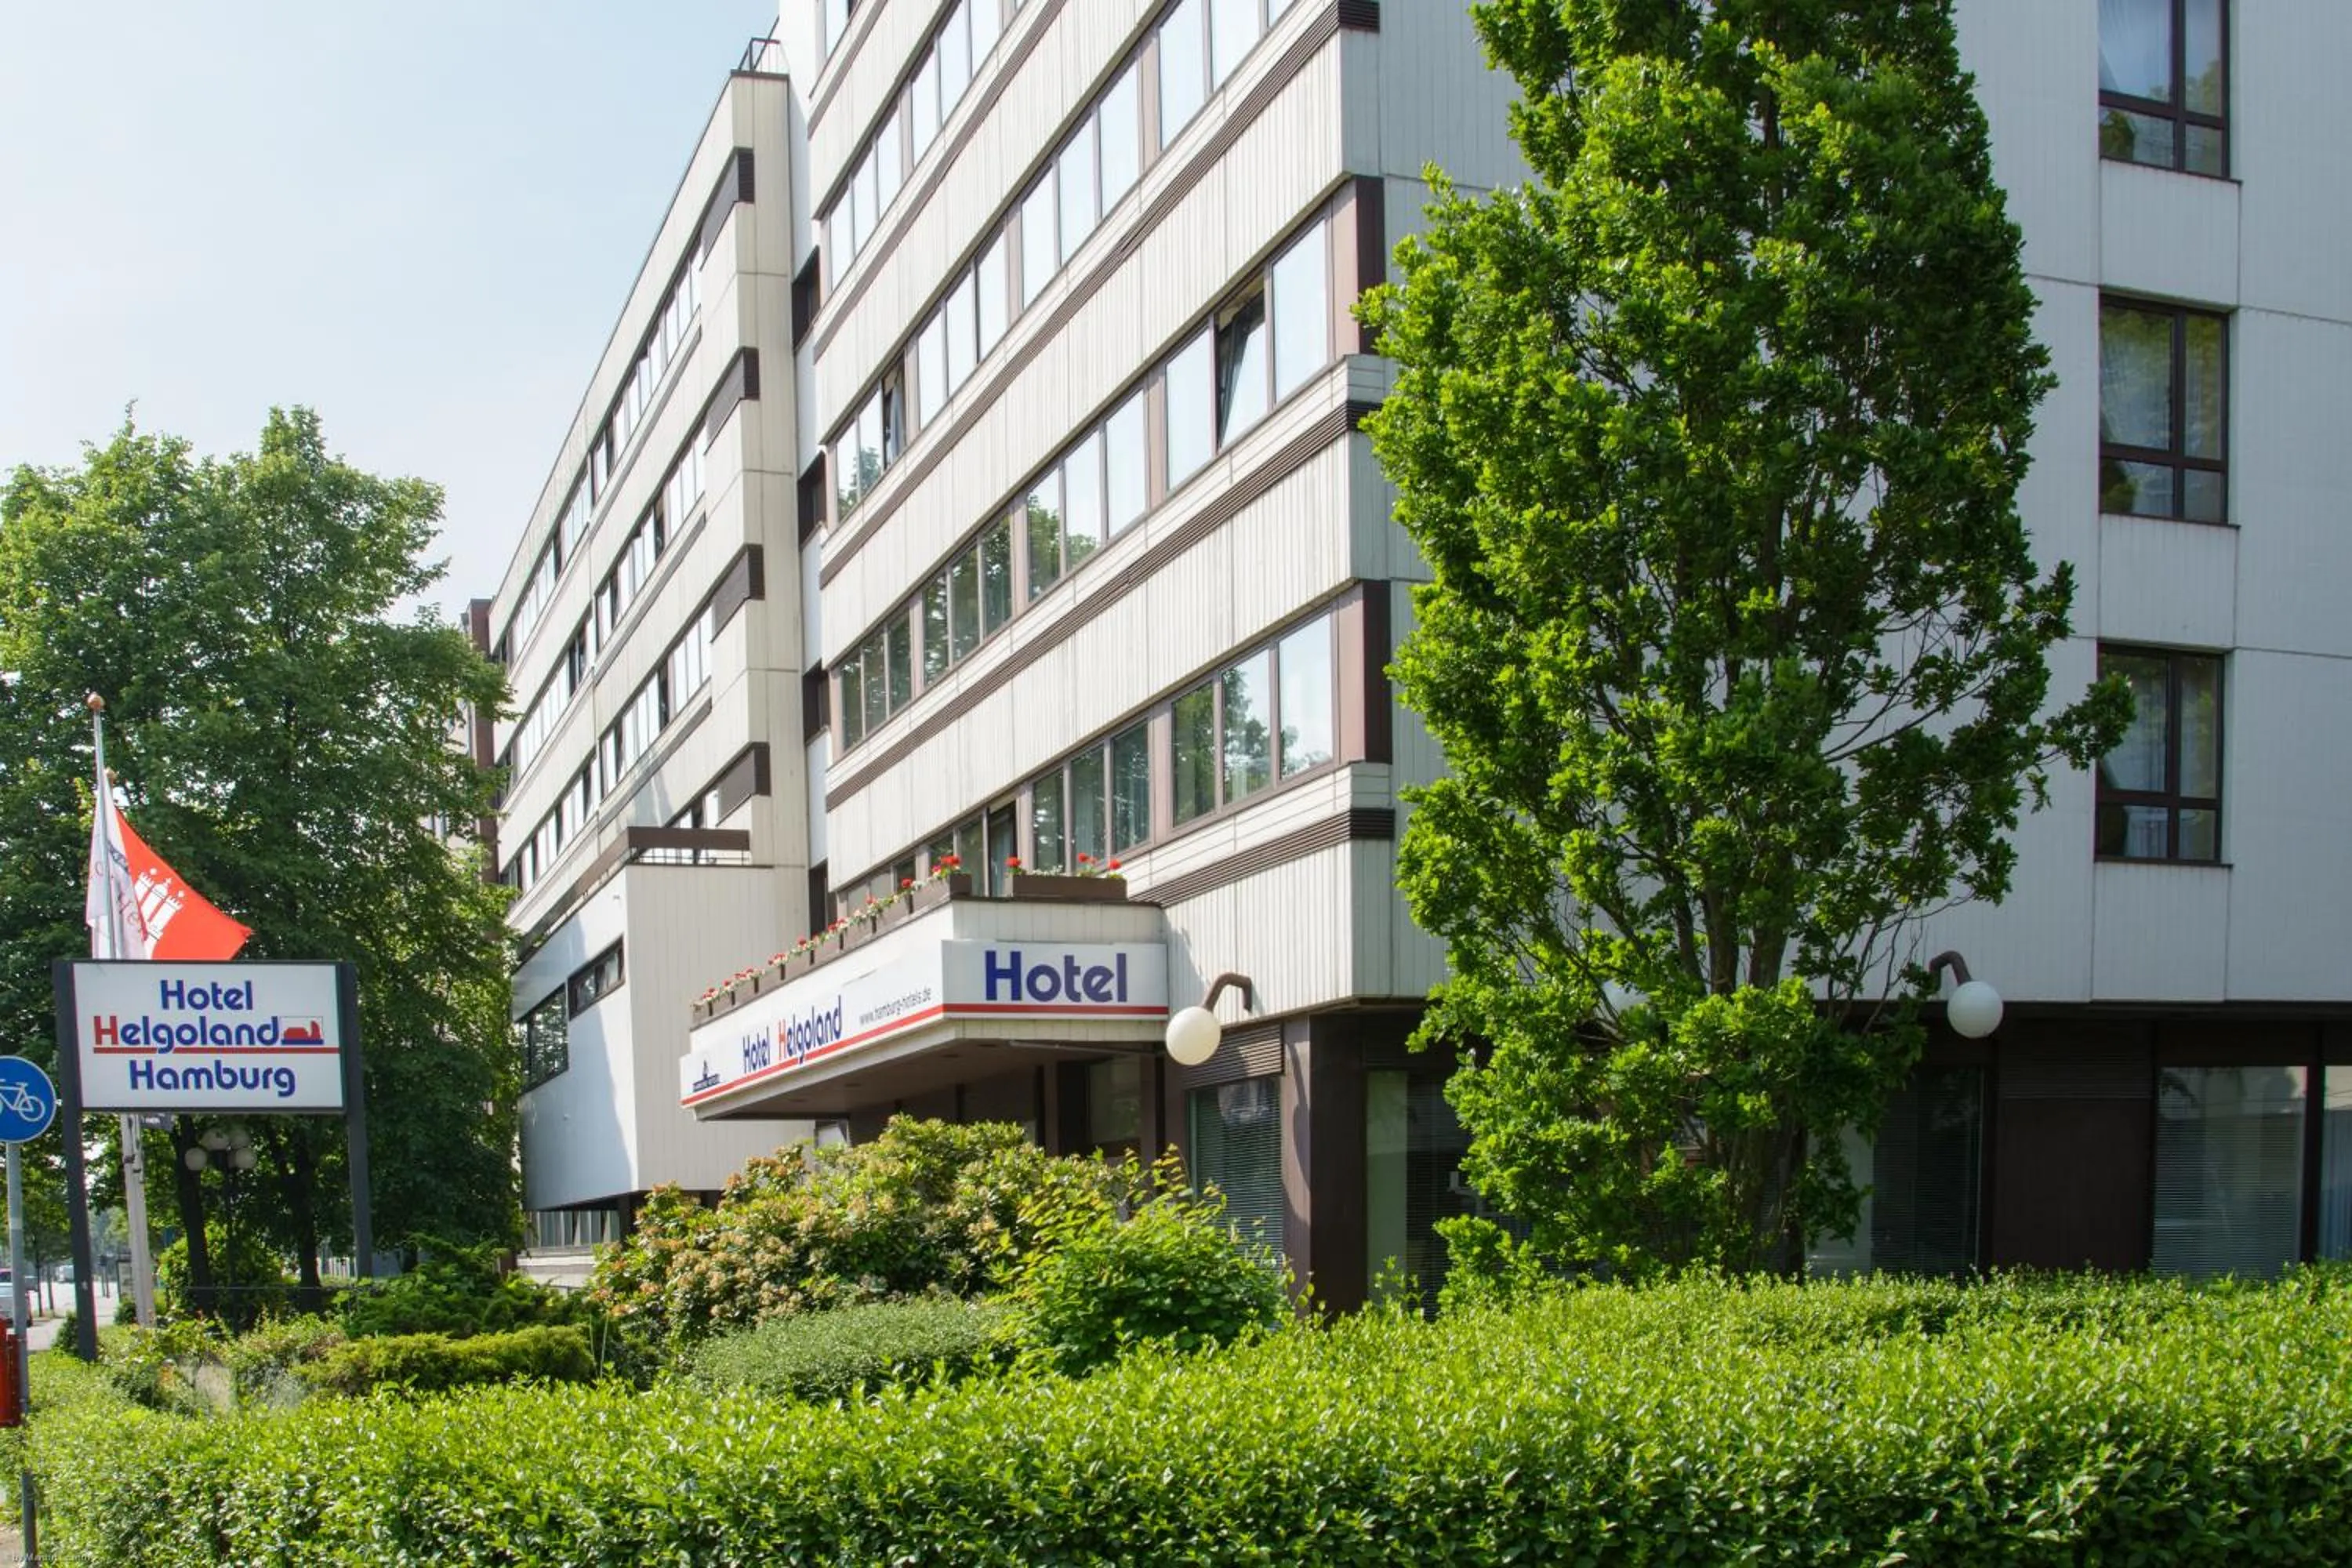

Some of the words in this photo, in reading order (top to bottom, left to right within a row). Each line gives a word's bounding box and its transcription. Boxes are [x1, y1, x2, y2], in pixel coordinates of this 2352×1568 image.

[161, 980, 253, 1011] Hotel
[985, 950, 1127, 1003] Hotel
[93, 1016, 278, 1054] Helgoland
[742, 1025, 771, 1074] Hotel
[778, 994, 842, 1064] Helgoland
[129, 1060, 296, 1096] Hamburg
